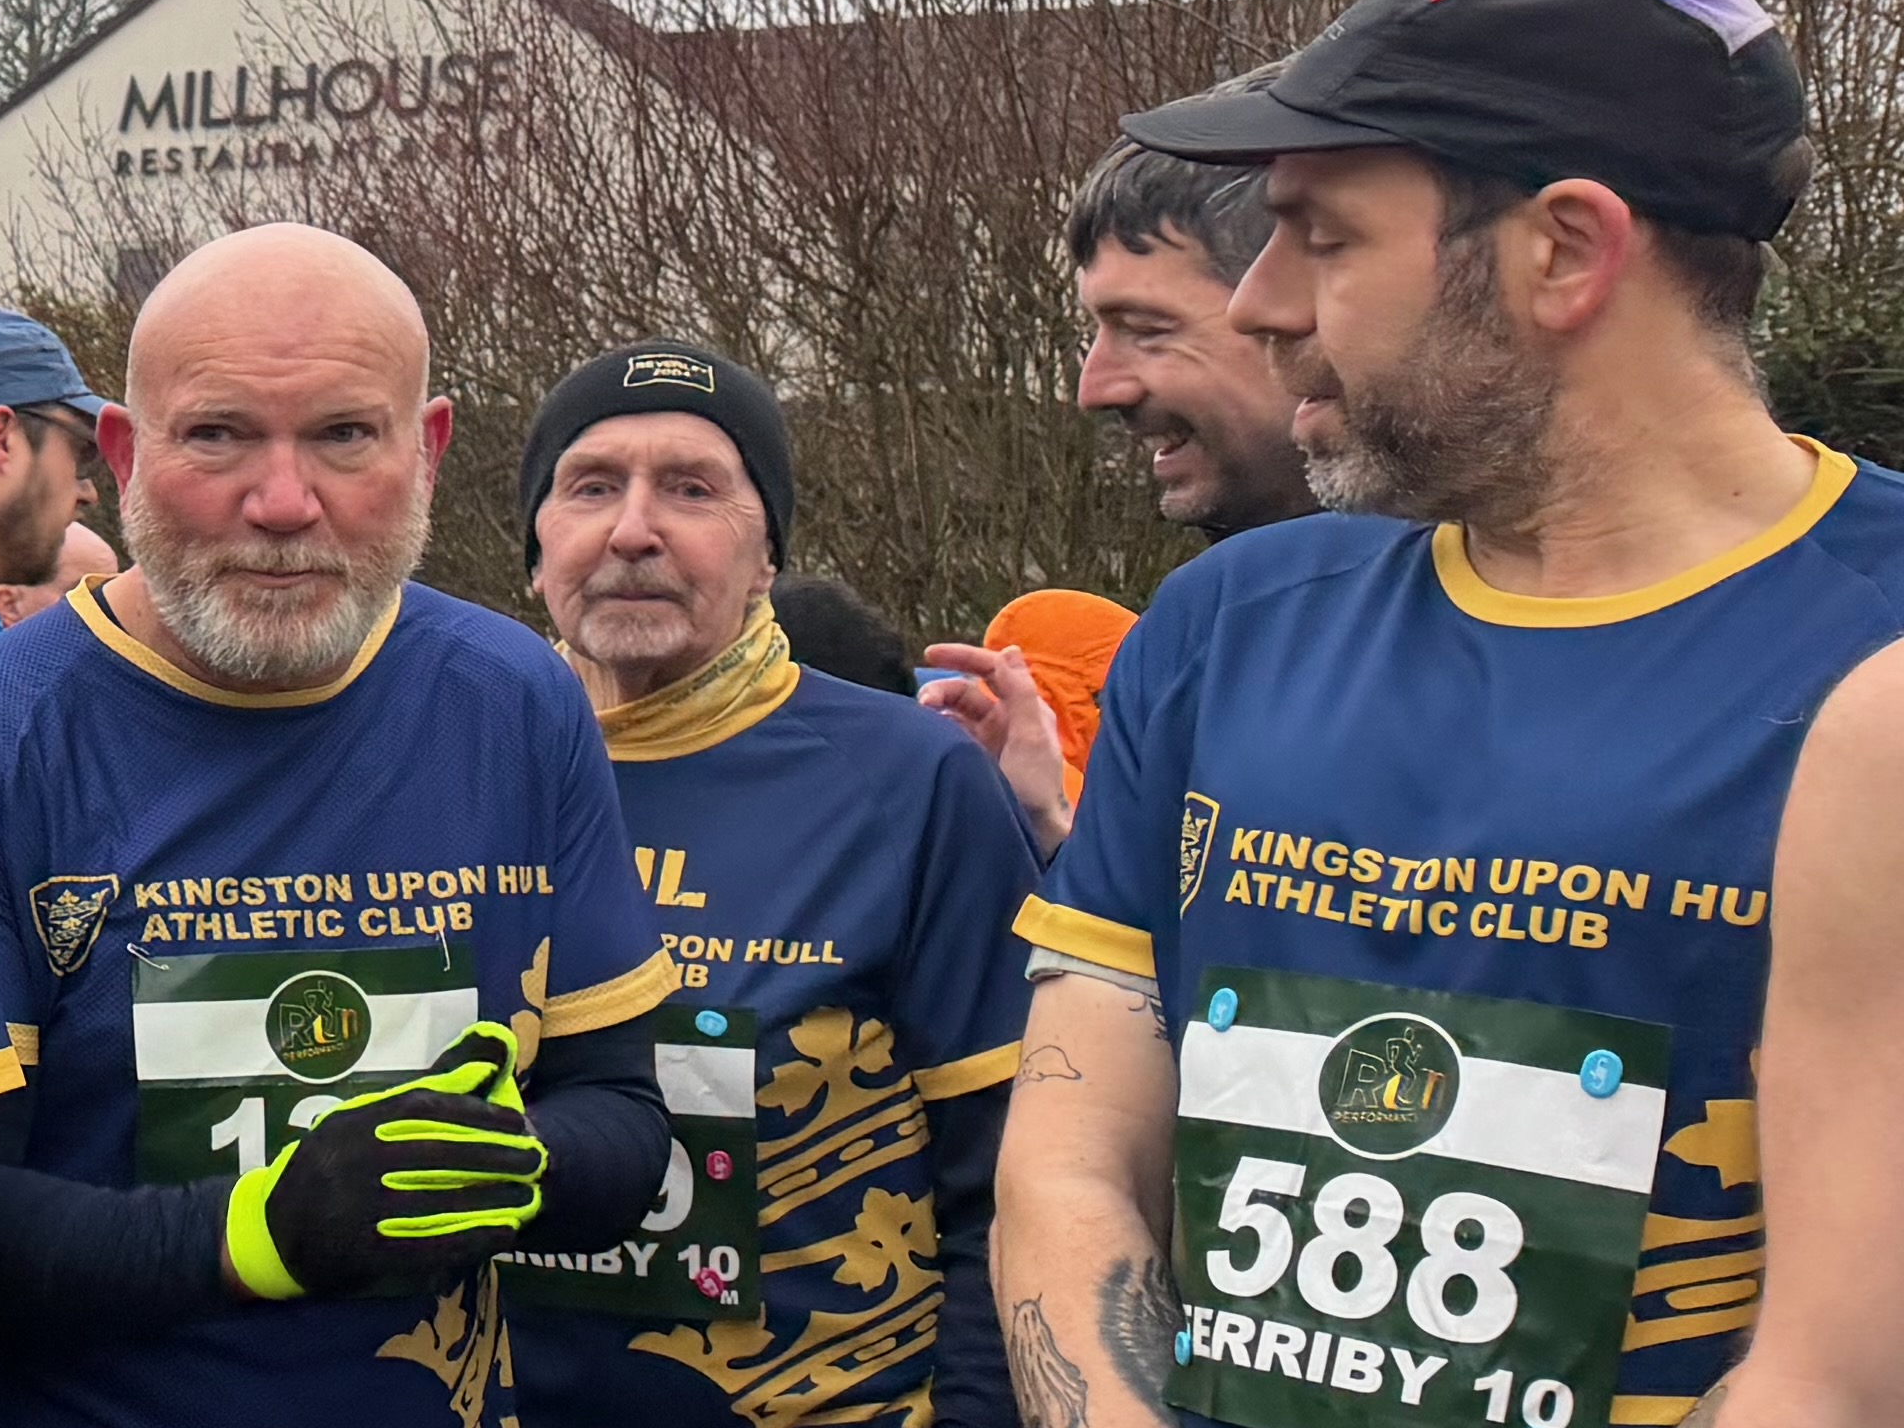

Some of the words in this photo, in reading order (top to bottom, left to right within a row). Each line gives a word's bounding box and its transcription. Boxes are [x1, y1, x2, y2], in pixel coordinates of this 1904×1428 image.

[119, 51, 514, 133] MILLHOUSE
[116, 134, 384, 176] RESTAURA
[134, 875, 352, 909] KINGSTON
[367, 866, 486, 901] UPON
[1230, 828, 1475, 894] KINGSTON
[1489, 856, 1649, 909] UPON
[142, 908, 344, 942] ATHLETIC
[359, 902, 472, 935] CLUB
[1225, 869, 1456, 936] ATHLETIC
[1470, 903, 1610, 950] CLUB
[744, 938, 843, 964] HULL
[678, 1244, 740, 1282] 10
[1206, 1156, 1524, 1345] 588
[720, 1290, 739, 1305] M
